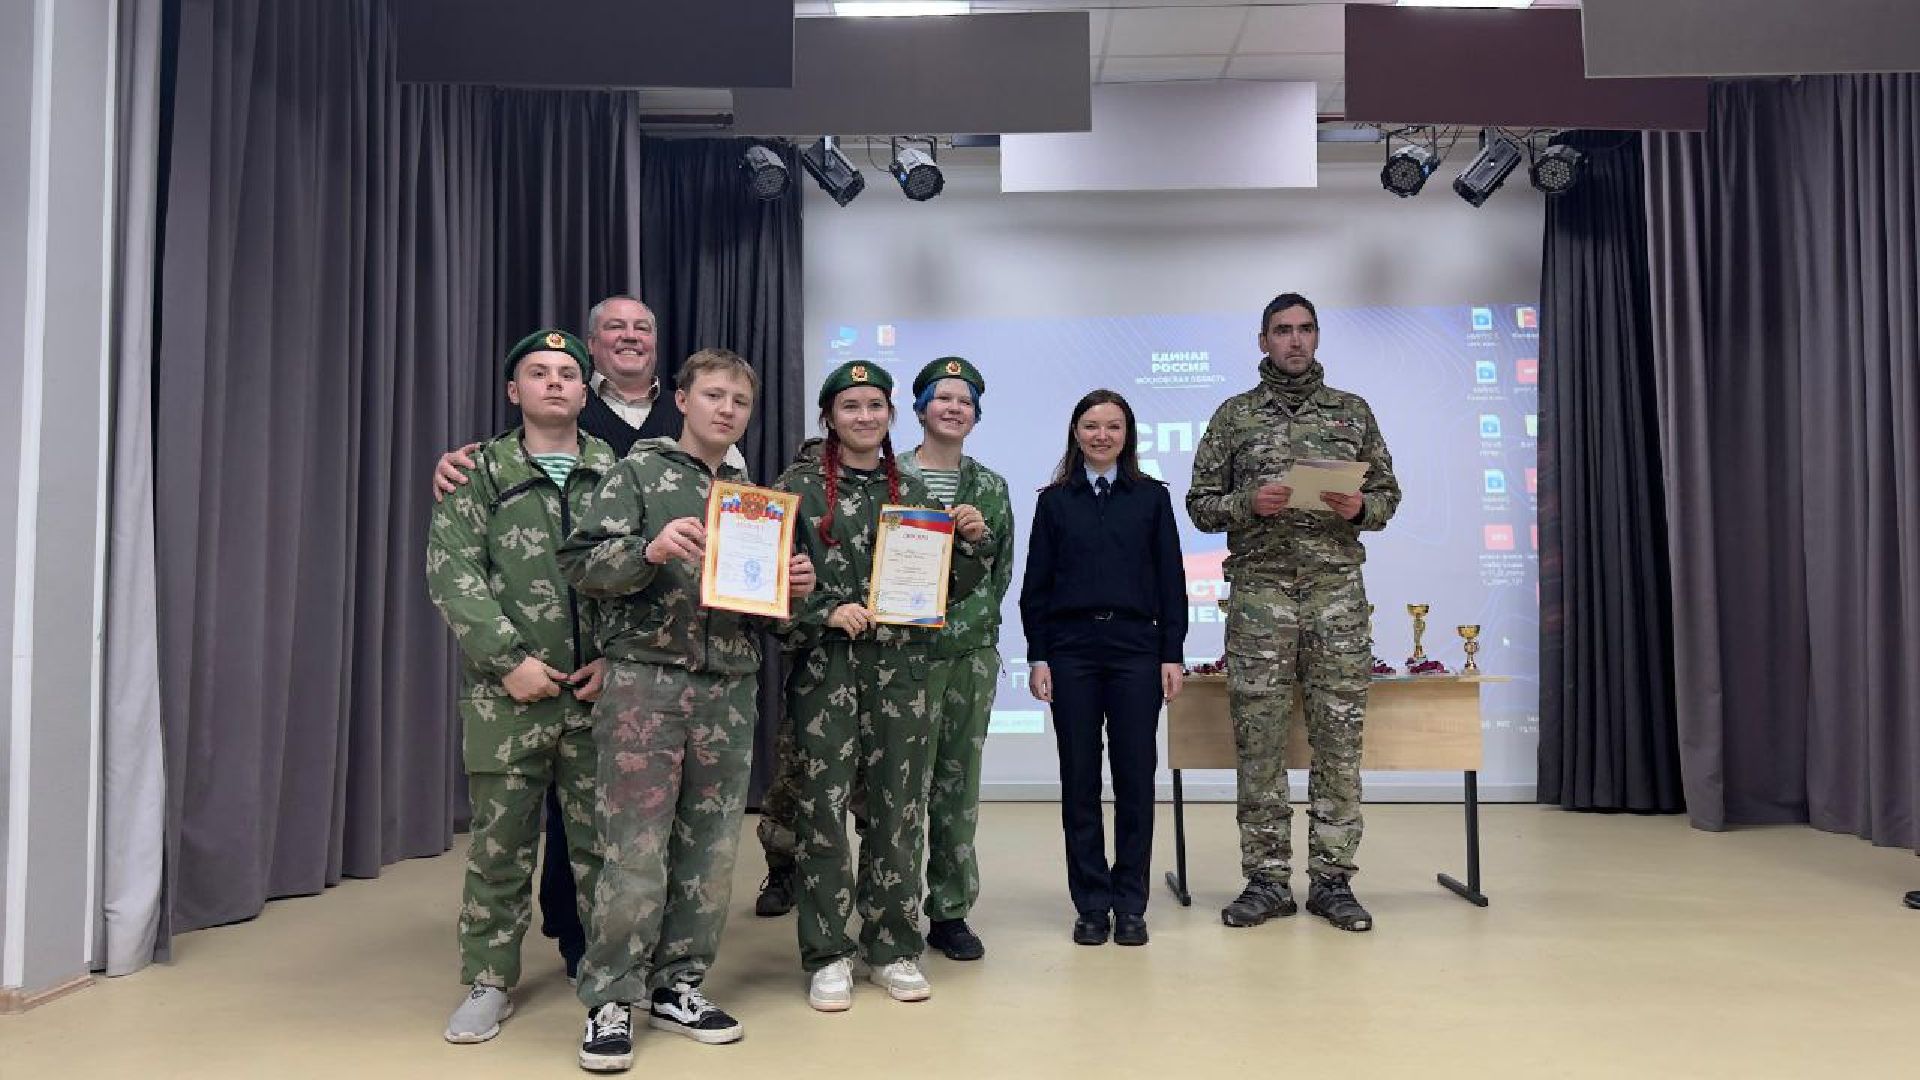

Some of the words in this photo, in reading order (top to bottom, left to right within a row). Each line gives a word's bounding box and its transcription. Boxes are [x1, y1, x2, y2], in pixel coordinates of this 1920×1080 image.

[1152, 351, 1209, 361] ЕДИНАЯ
[1152, 363, 1209, 373] РОССИЯ
[1135, 376, 1190, 385] МОСКОВСКАЯ
[1190, 375, 1225, 384] ОБЛАСТЬ
